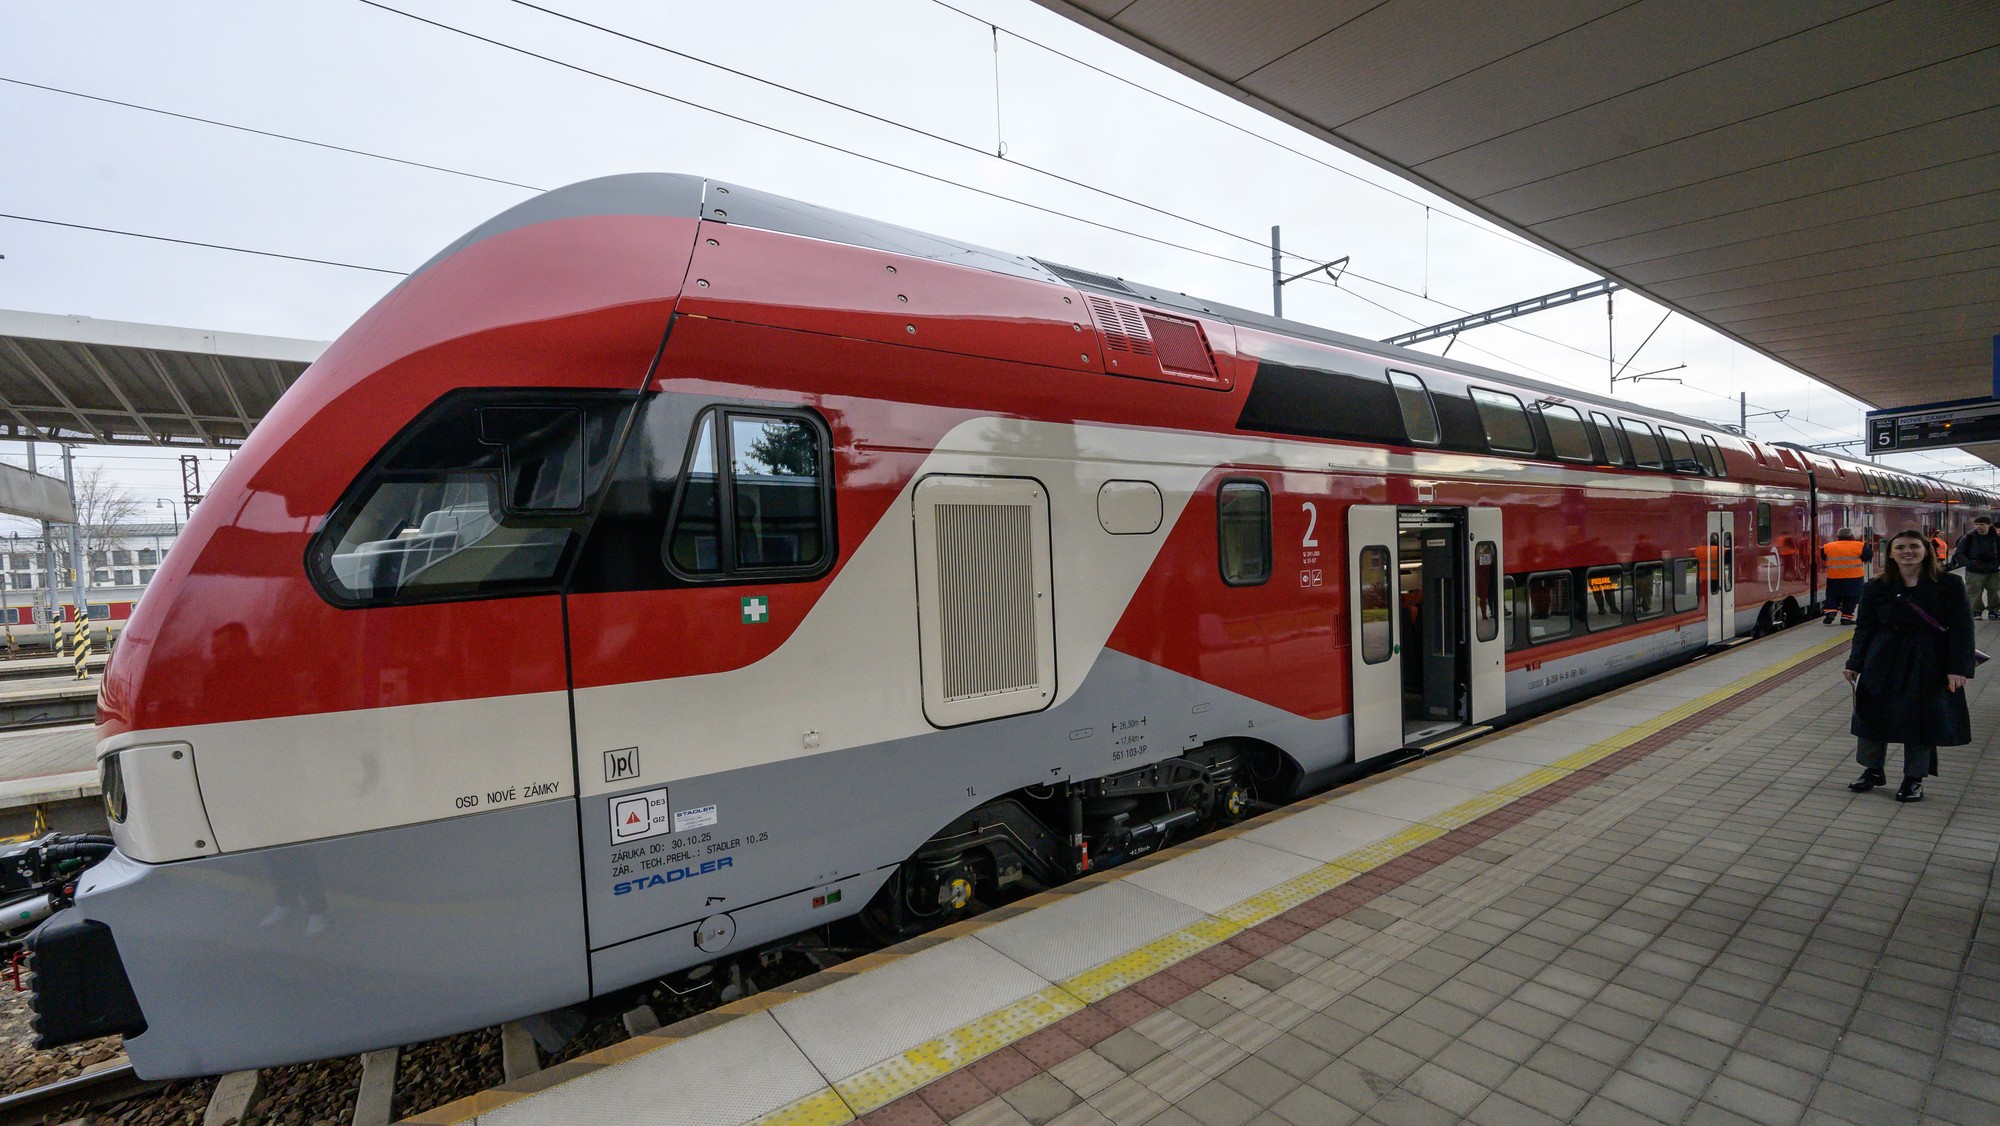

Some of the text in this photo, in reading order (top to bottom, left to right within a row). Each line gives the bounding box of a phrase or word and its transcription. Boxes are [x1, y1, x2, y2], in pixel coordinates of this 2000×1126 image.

[1878, 432, 1891, 445] 5
[1302, 501, 1318, 547] 2
[1112, 750, 1124, 762] 561
[455, 782, 560, 809] OSD NOVÉ ZÁMKY
[966, 786, 976, 798] 1L
[650, 799, 666, 807] DE3
[676, 806, 715, 818] STADLER
[611, 832, 712, 863] ZÁRUKA DO: 30.10.25
[612, 864, 634, 878] ZÁR.
[706, 838, 741, 855] STADLER
[746, 832, 769, 845] 10.25
[613, 856, 734, 896] STADLER
